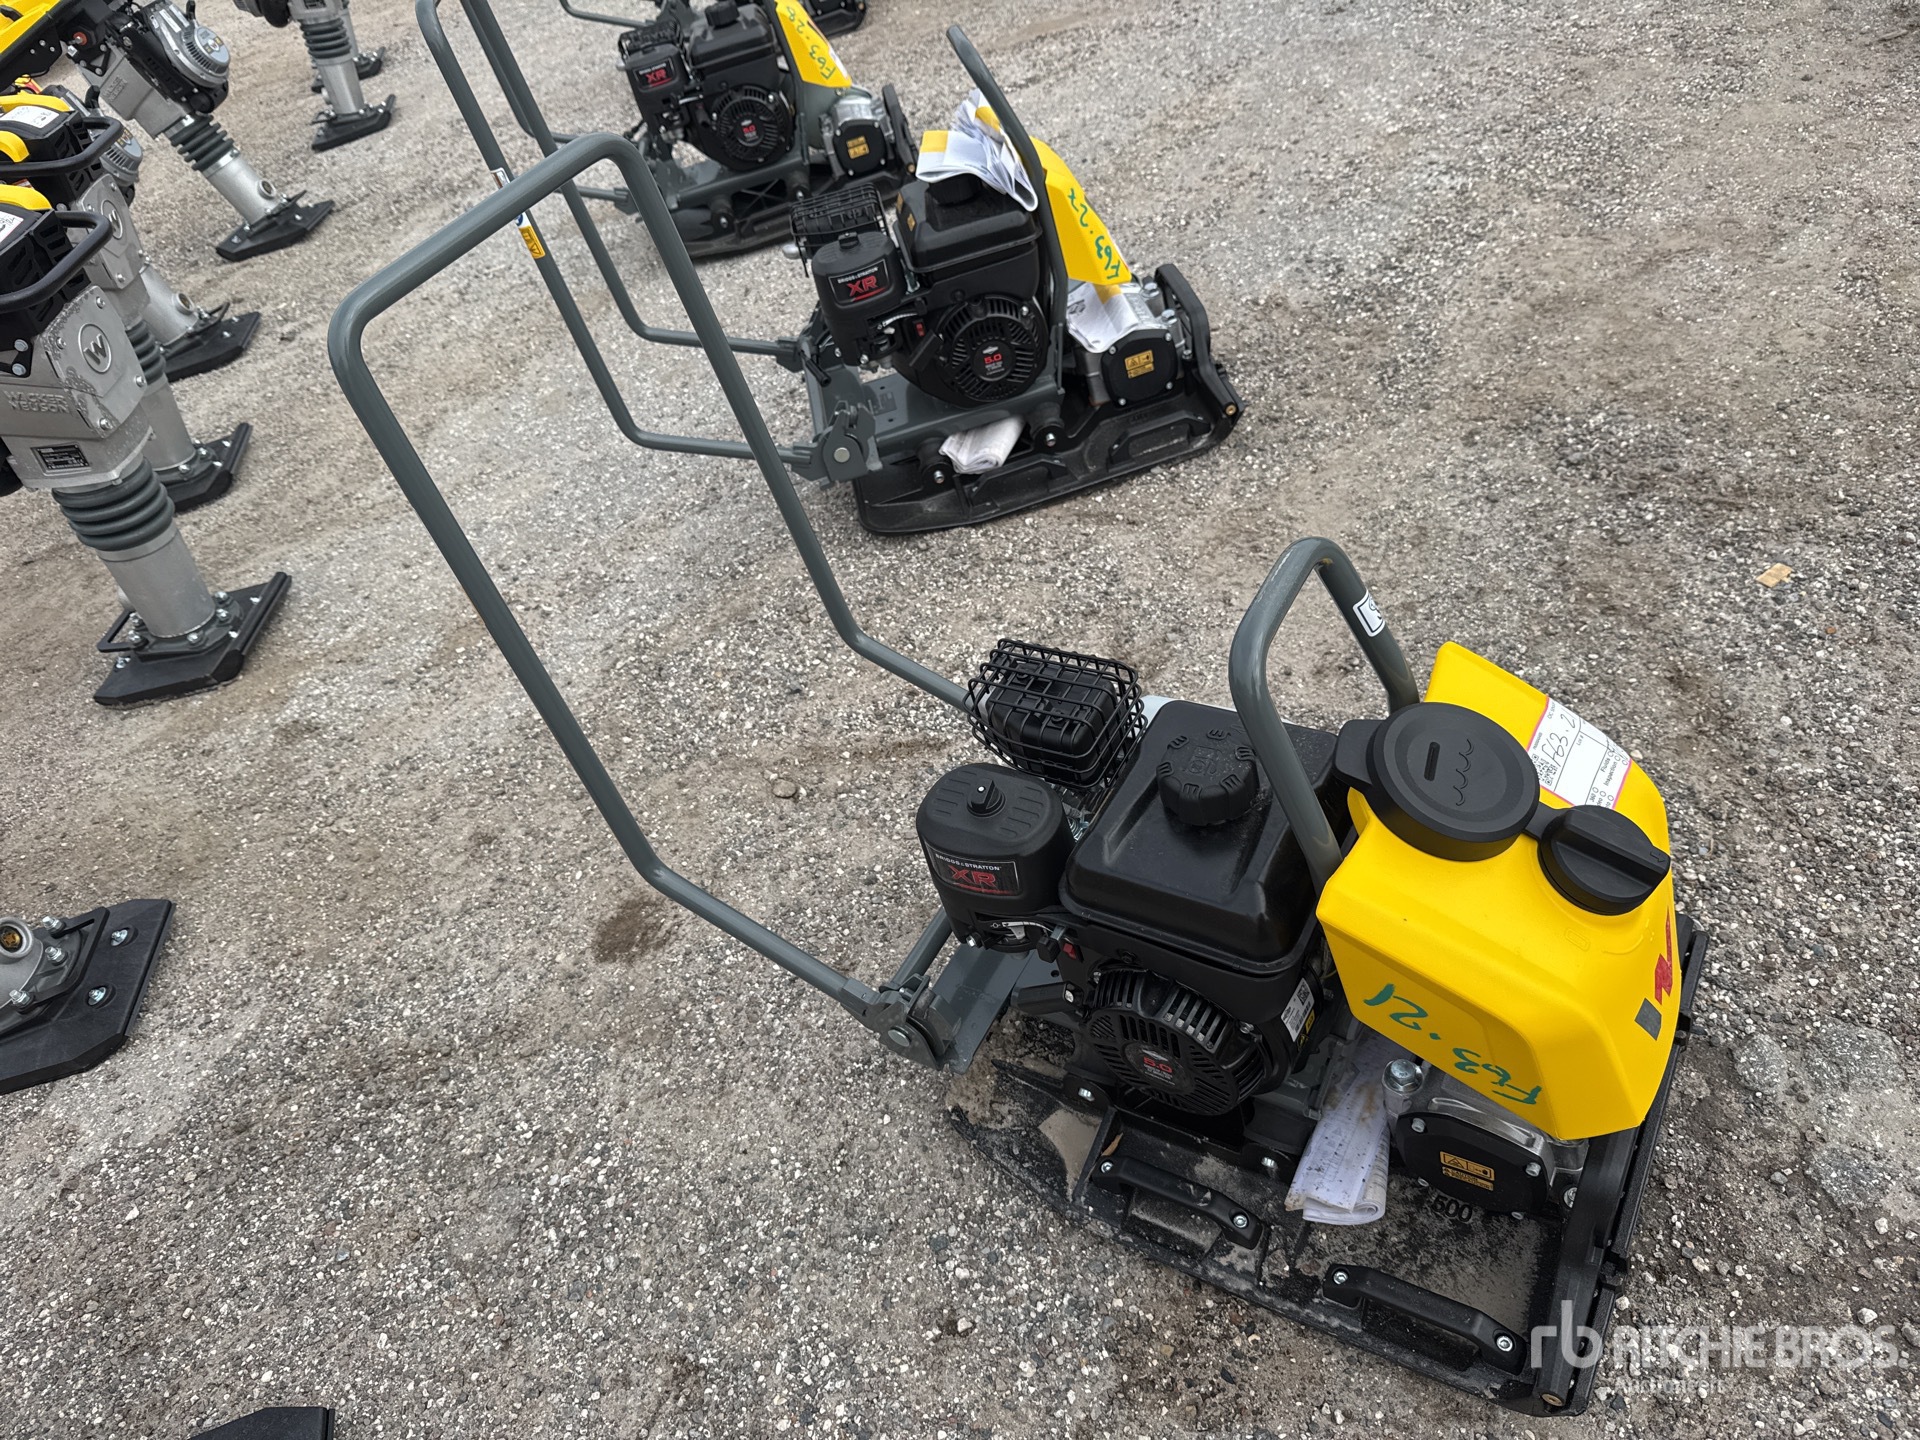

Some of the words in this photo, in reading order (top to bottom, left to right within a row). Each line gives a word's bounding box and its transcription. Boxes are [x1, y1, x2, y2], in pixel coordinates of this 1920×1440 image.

[645, 68, 667, 84] XR
[846, 275, 878, 297] XR
[984, 353, 1002, 364] 5.0
[1600, 756, 1611, 773] Fluids
[1603, 761, 1618, 786] Inspection
[935, 853, 960, 867] BRIGGS
[964, 861, 1000, 871] STRATTON
[947, 865, 997, 888] XR
[1143, 1056, 1173, 1074] 5.0
